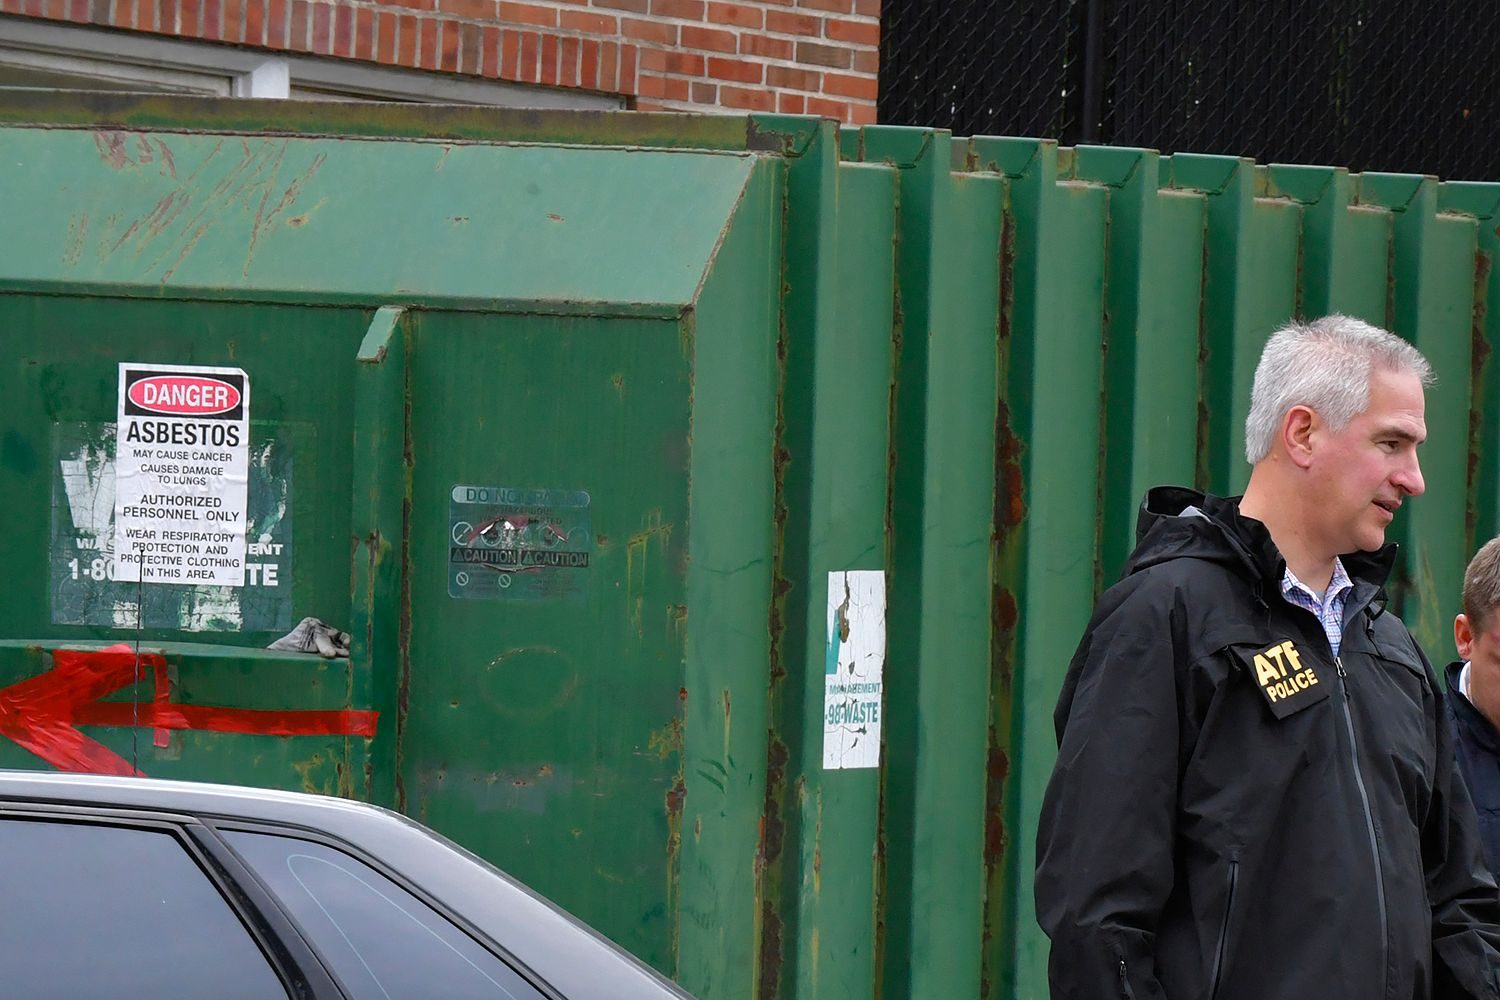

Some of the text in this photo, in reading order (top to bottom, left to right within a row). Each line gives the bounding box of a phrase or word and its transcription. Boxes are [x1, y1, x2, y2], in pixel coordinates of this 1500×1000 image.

[143, 382, 229, 408] DANGER
[126, 420, 240, 447] ASBESTOS
[133, 449, 233, 462] MAY CAUSE CANCER
[140, 463, 224, 476] CAUSES DAMAGE
[158, 475, 207, 486] TO LUNGS
[140, 494, 222, 508] AUTHORIZED
[123, 506, 240, 522] PERSONNEL ONLY
[126, 529, 236, 543] WEAR RESPIRATORY
[132, 542, 228, 555] PROTECTION AND
[120, 553, 240, 568] PROTECTIVE CLOTHING
[463, 549, 588, 567] CAUTION CAUTION
[143, 567, 216, 580] IN THIS AREA
[1253, 640, 1303, 687] ATF
[1266, 668, 1319, 703] POLICE
